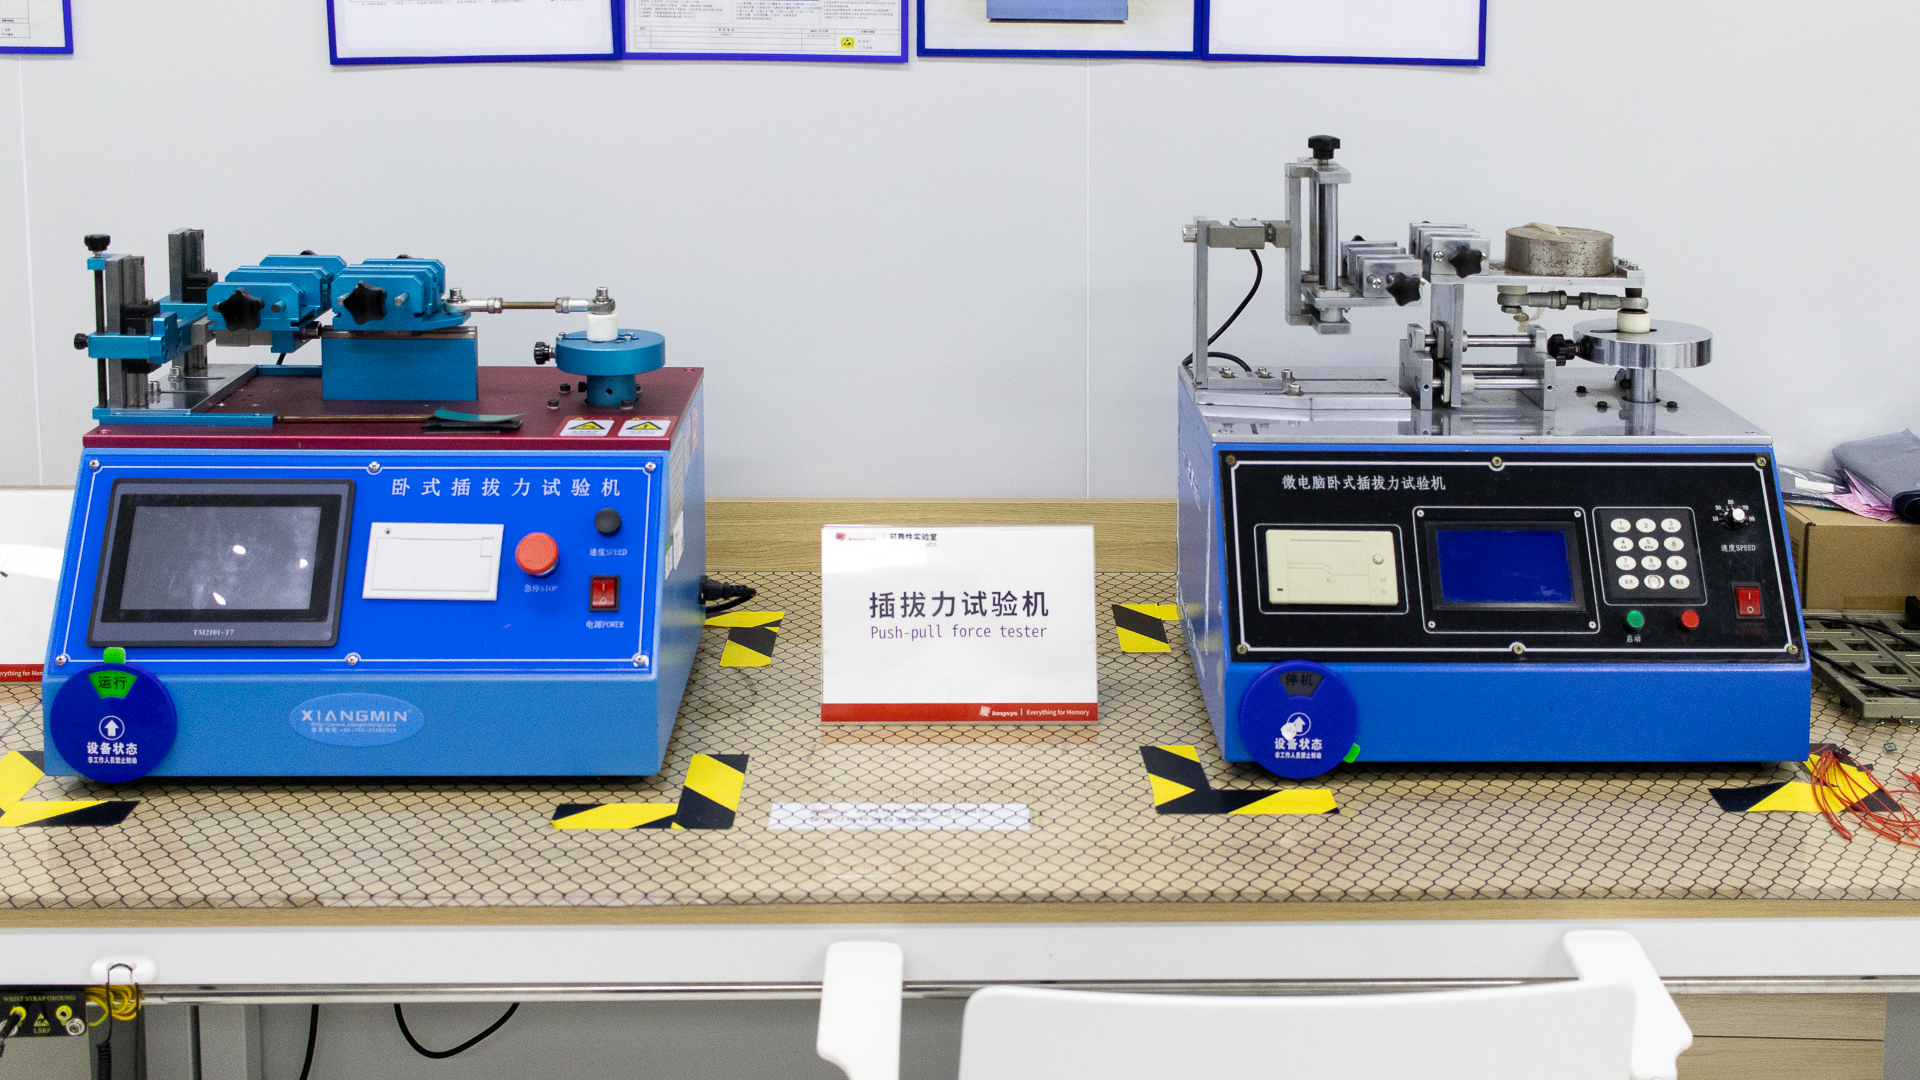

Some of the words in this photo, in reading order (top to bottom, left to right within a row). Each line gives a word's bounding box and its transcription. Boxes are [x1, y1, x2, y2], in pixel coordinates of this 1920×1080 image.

[391, 477, 621, 498] 卧式插拔力试验机
[1281, 475, 1447, 492] 微电脑卧式插拔力试验机
[869, 590, 1049, 619] 插拔力试验机
[870, 624, 943, 642] Push-pull
[952, 623, 991, 639] force
[1000, 624, 1047, 639] tester
[97, 675, 128, 690] 运行
[1285, 673, 1313, 687] 停机
[301, 709, 408, 722] XIANGMIN
[1026, 709, 1057, 717] Everything
[1066, 709, 1090, 717] Memory
[86, 741, 138, 755] 设备状态
